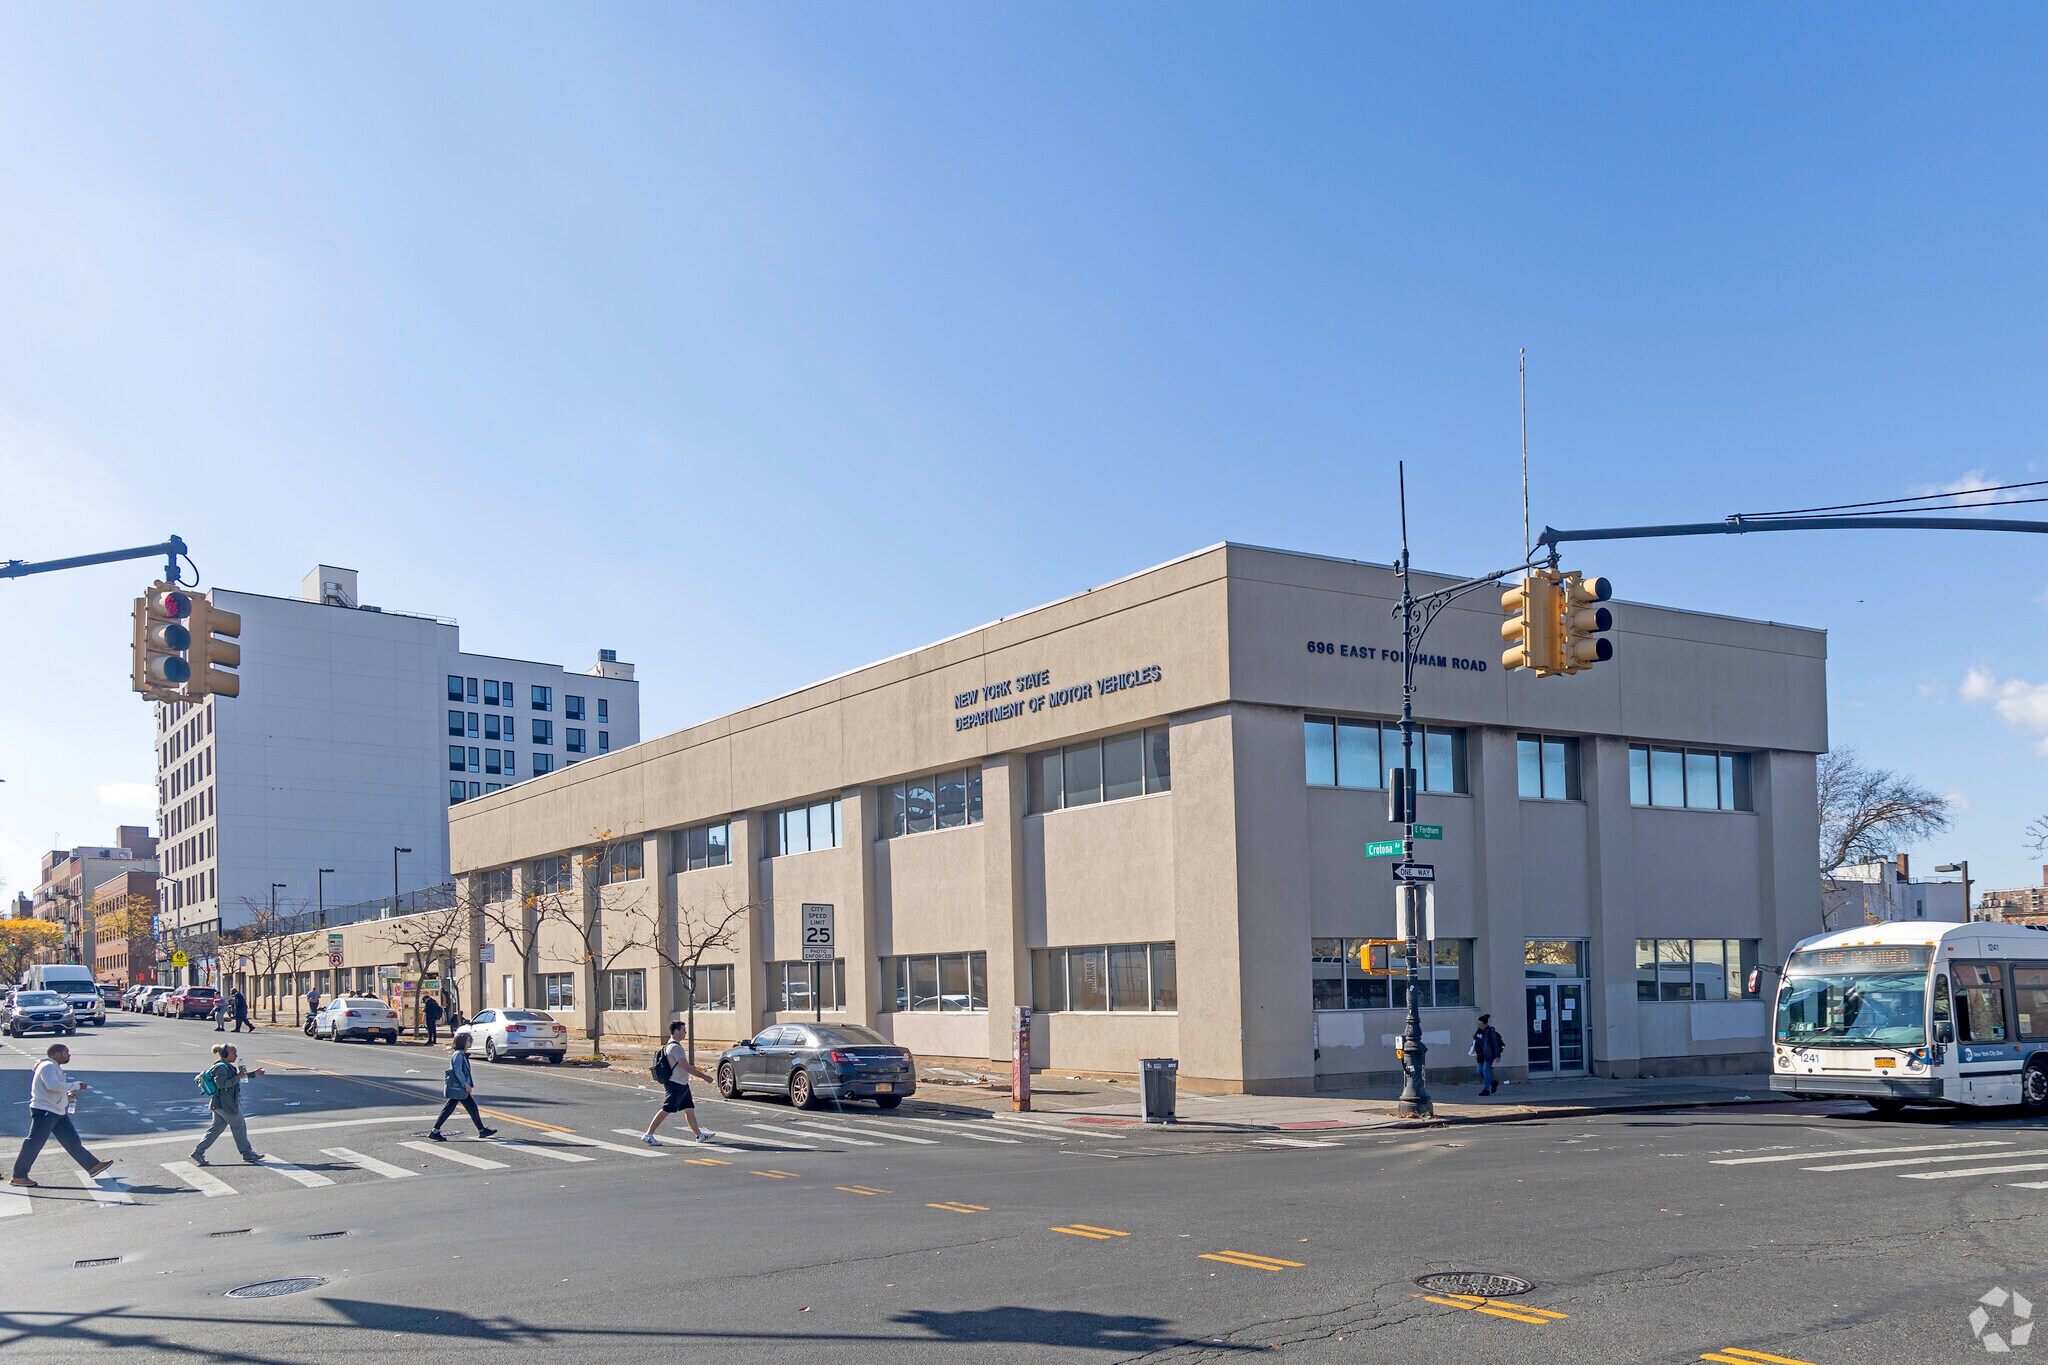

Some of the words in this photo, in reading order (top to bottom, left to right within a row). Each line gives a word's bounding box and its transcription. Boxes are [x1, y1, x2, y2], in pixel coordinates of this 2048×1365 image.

[1307, 641, 1335, 655] 696
[1340, 644, 1376, 660] EAST
[1451, 657, 1487, 672] ROAD
[954, 689, 979, 709] NEW
[982, 680, 1012, 701] YORK
[1015, 669, 1050, 692] STATE
[955, 700, 1025, 732] DEPARTMENT
[1028, 694, 1046, 713] OF
[1048, 683, 1092, 708] MOTOR
[1097, 664, 1162, 695] VEHICLES
[1420, 825, 1439, 834] Fordham
[1368, 844, 1393, 855] Crotona
[1400, 868, 1412, 876] ONE
[806, 927, 830, 943] 25
[1987, 943, 1999, 952] 1241
[1800, 1053, 1820, 1063] 1241
